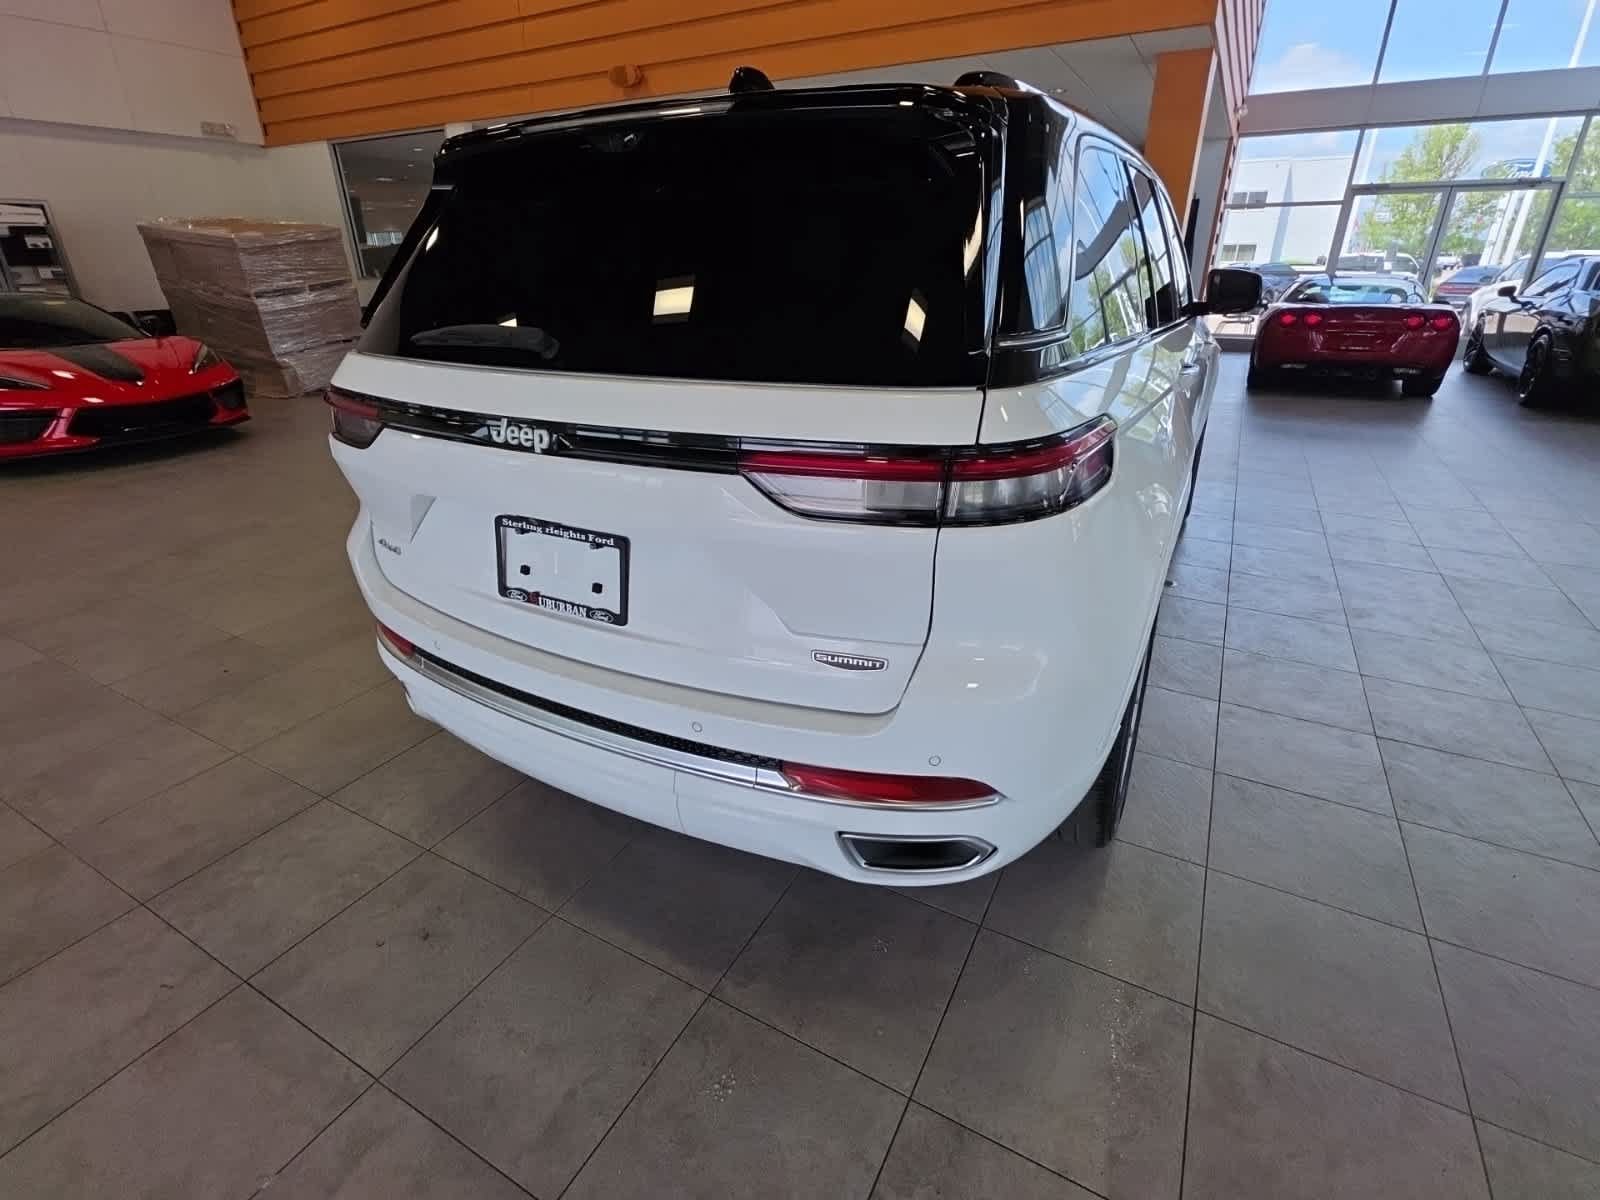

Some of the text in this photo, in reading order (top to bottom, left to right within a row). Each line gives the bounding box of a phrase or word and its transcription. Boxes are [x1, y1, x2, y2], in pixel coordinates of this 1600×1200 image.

[487, 417, 550, 454] Jeep
[502, 518, 615, 546] Sterling Heights Ford
